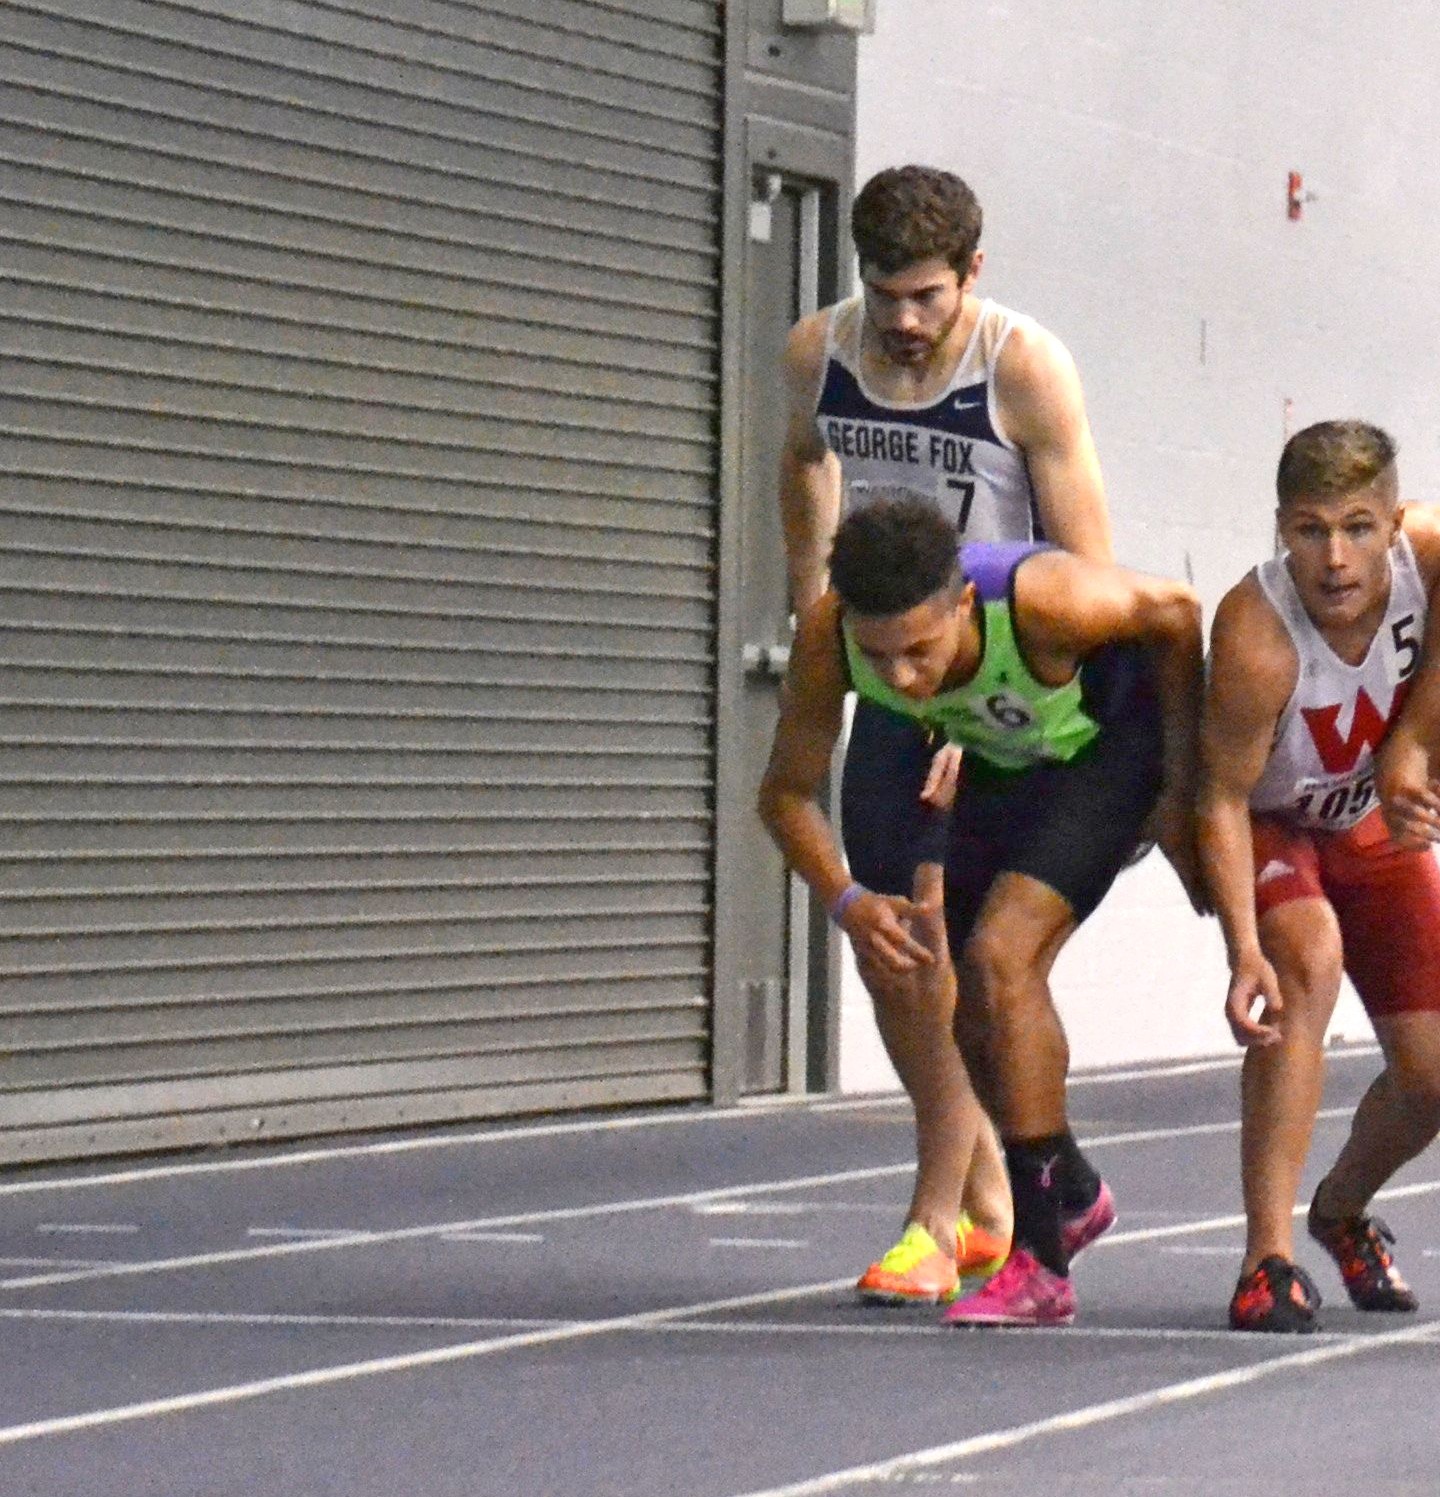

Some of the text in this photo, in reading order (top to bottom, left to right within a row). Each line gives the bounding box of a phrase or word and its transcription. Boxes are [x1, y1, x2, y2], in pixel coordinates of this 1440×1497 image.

[827, 421, 976, 475] GEORGE FOX
[947, 479, 974, 533] 7
[1391, 614, 1420, 678] 5
